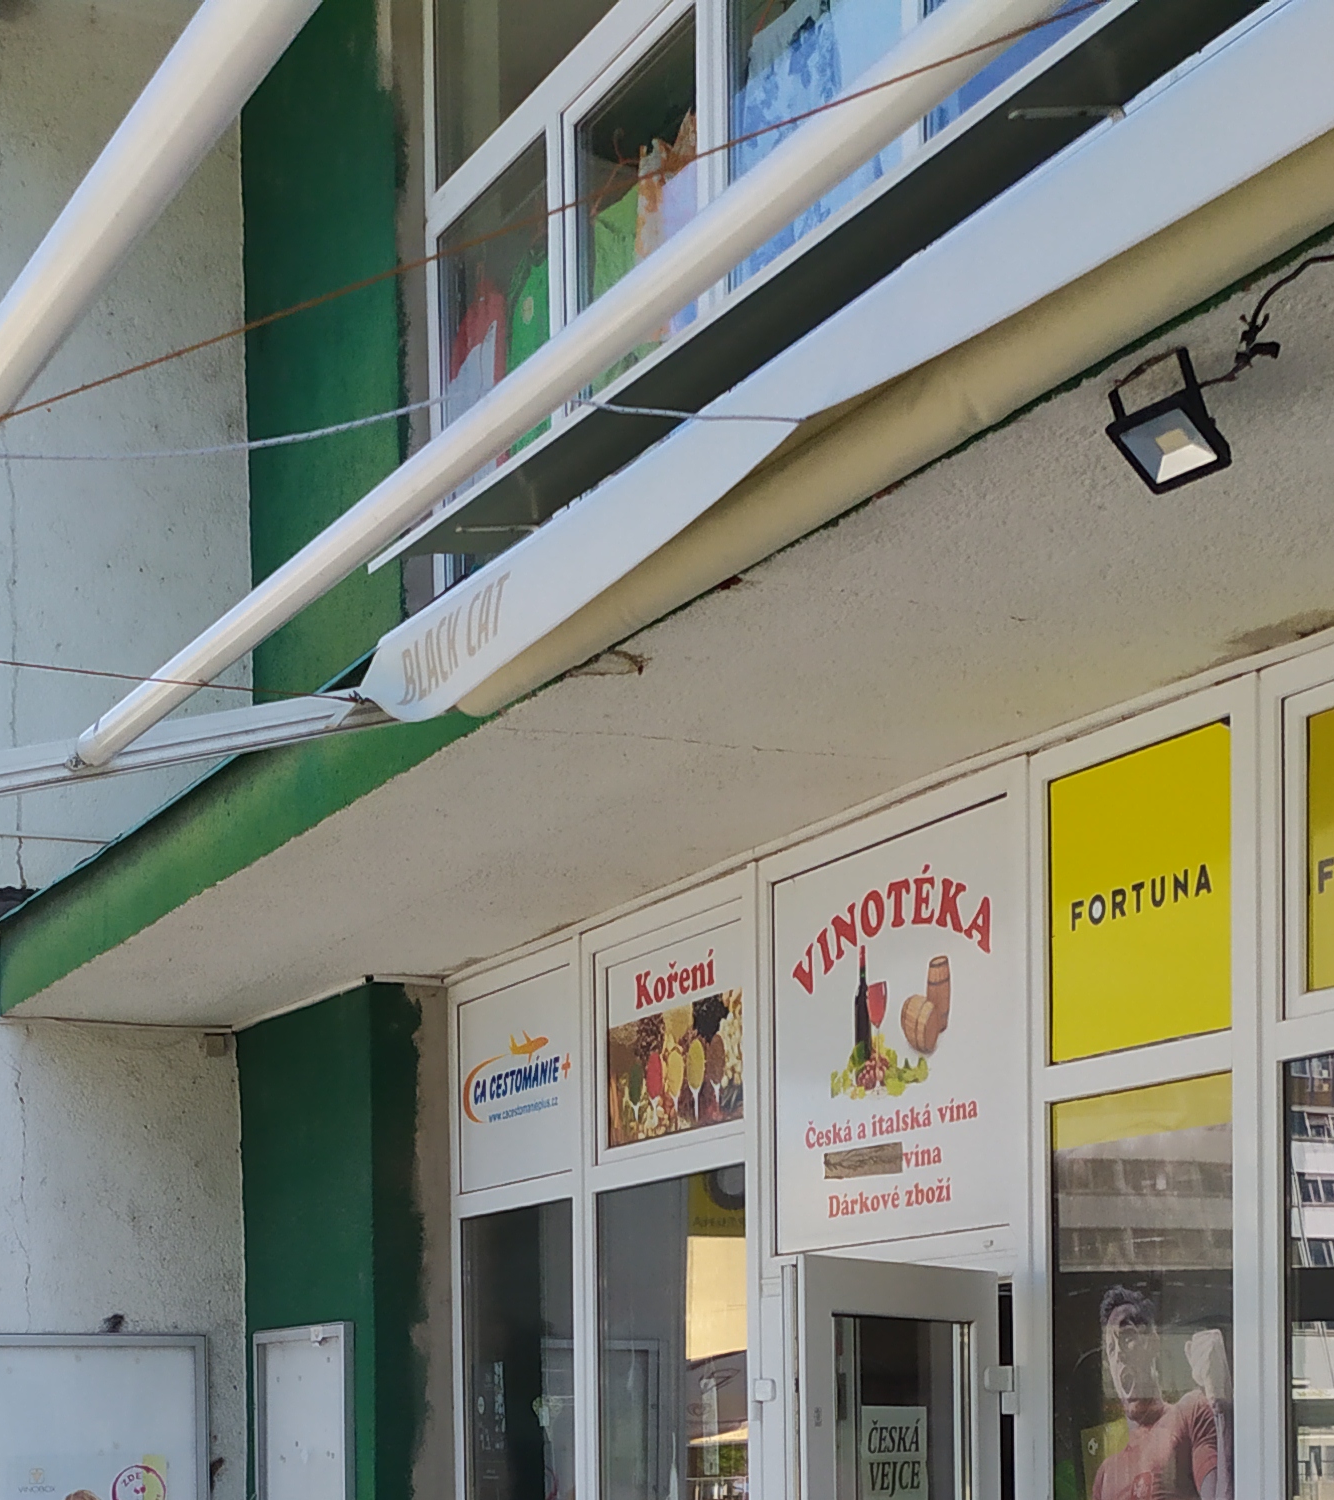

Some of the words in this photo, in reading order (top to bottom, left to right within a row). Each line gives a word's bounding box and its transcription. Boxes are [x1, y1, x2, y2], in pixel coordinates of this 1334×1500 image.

[397, 606, 462, 706] BLACK
[467, 571, 511, 657] CAT
[1070, 864, 1212, 932] FORTUNA
[792, 863, 991, 995] VINOTÉKA
[635, 948, 714, 1009] Koření
[473, 1078, 487, 1105] CA
[489, 1055, 560, 1101] CESTOMÁNIE
[805, 1120, 853, 1150] Česká
[857, 1122, 867, 1140] a
[871, 1103, 932, 1138] italská
[937, 1098, 978, 1124] vína
[902, 1144, 942, 1168] vína
[828, 1185, 900, 1218] Dárkové
[905, 1177, 951, 1207] zboží
[867, 1418, 921, 1454] ČESKÁ
[121, 1472, 142, 1487] ZDE
[869, 1460, 921, 1497] VEJCE
